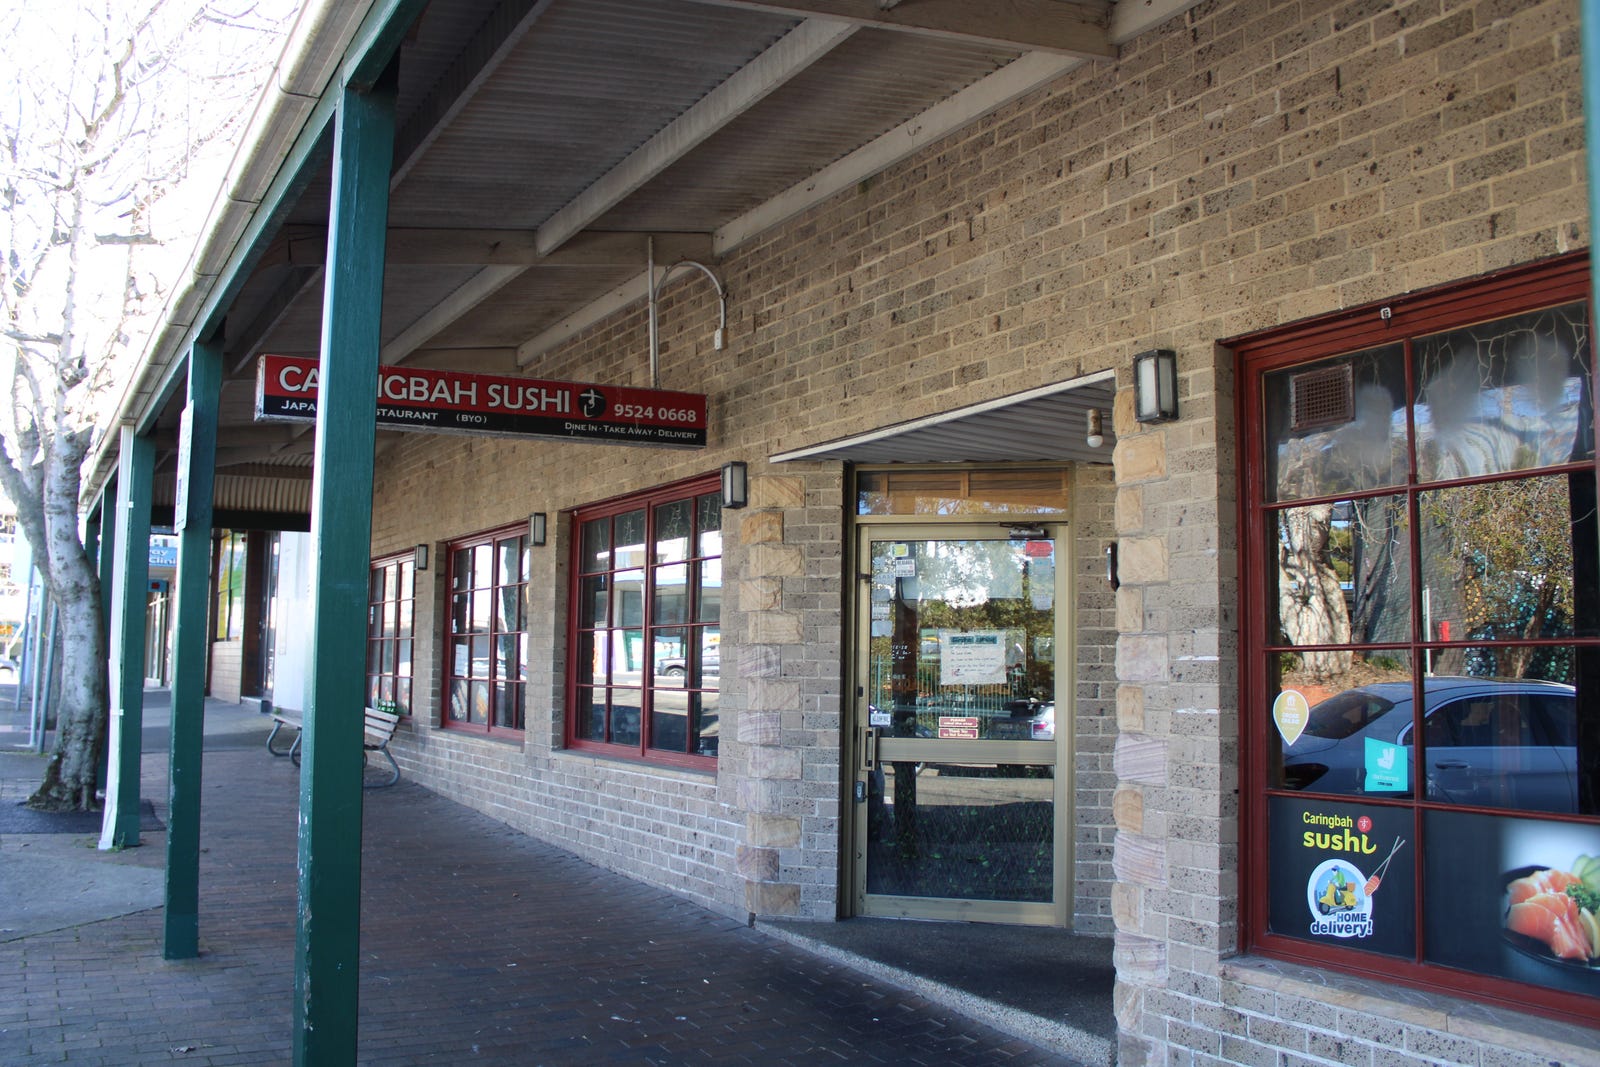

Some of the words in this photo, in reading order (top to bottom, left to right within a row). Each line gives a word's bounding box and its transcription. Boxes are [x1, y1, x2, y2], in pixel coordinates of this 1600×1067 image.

[279, 365, 477, 406] CAGBAH
[487, 383, 570, 413] SUSHI
[456, 414, 487, 424] (BYO)
[614, 403, 654, 419] 9524
[658, 407, 697, 423] 0668
[565, 422, 586, 431] DINE
[588, 424, 598, 432] IN
[603, 425, 626, 434] TAKE
[627, 427, 653, 436] AWAY
[658, 429, 697, 439] DELIVERY
[149, 557, 176, 565] Clini
[1303, 811, 1353, 829] Caringbah
[1336, 913, 1367, 922] HOME
[1311, 921, 1372, 936] delivery!
